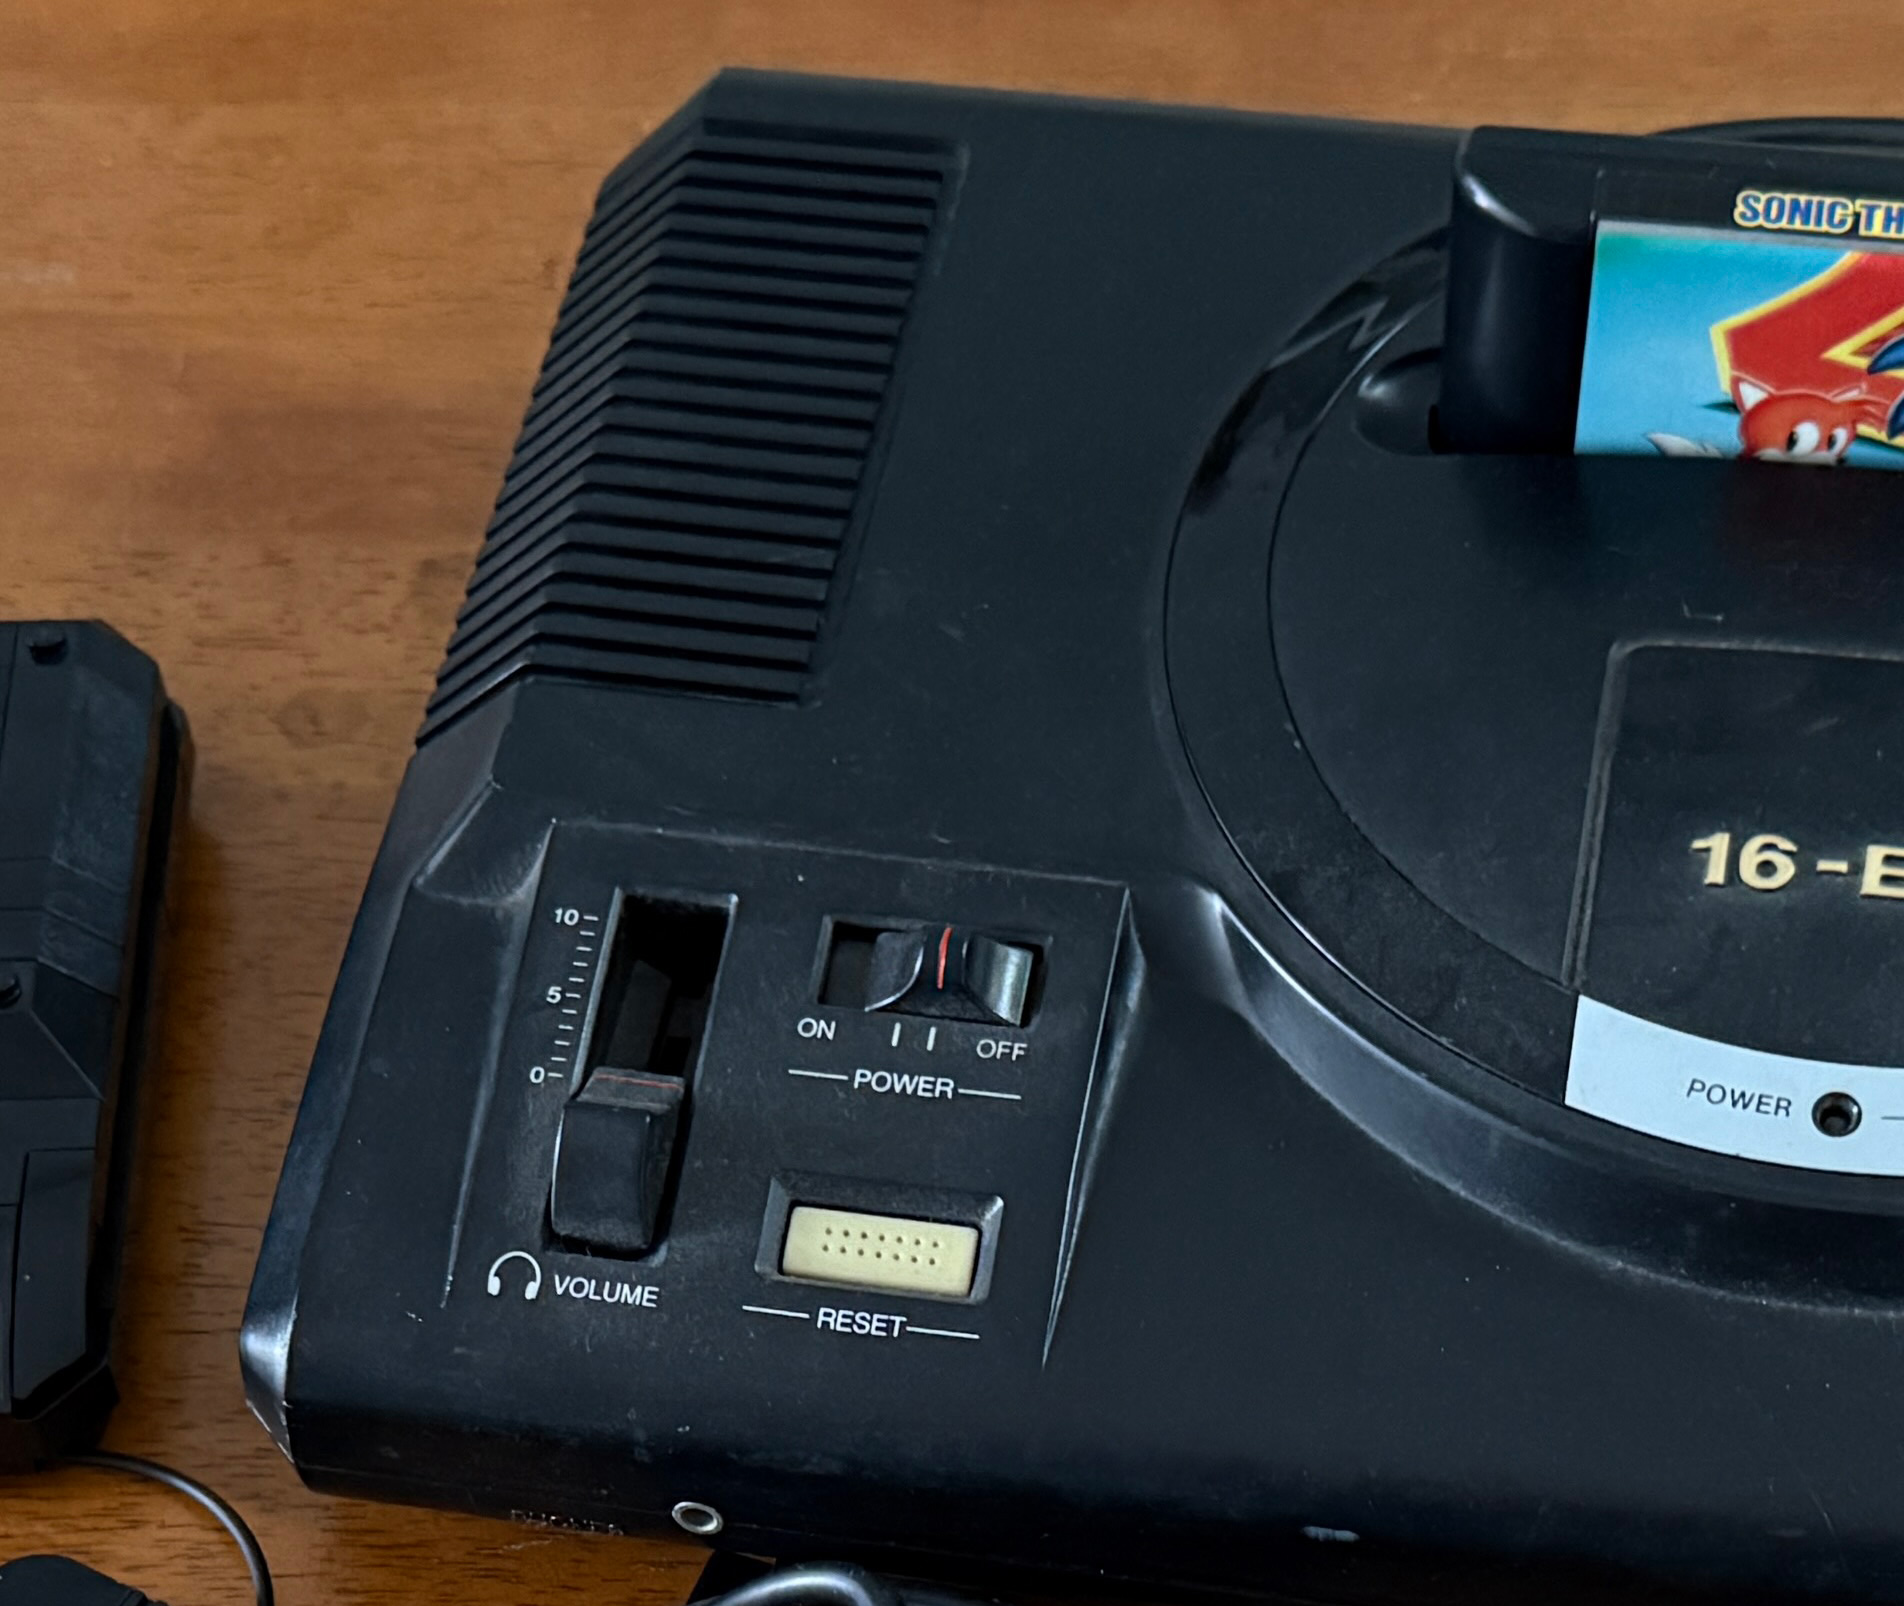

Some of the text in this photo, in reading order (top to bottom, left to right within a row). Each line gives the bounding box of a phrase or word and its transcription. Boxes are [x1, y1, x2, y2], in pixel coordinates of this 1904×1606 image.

[1734, 189, 1853, 233] SONIC
[555, 909, 580, 926] 10
[546, 986, 562, 1004] 5
[797, 1019, 836, 1041] ON
[976, 1038, 1028, 1062] OFF
[529, 1067, 546, 1085] 0
[854, 1069, 954, 1100] POWER
[1686, 1078, 1792, 1118] POWER
[553, 1275, 659, 1308] VOLUME
[816, 1308, 907, 1338] RESET
